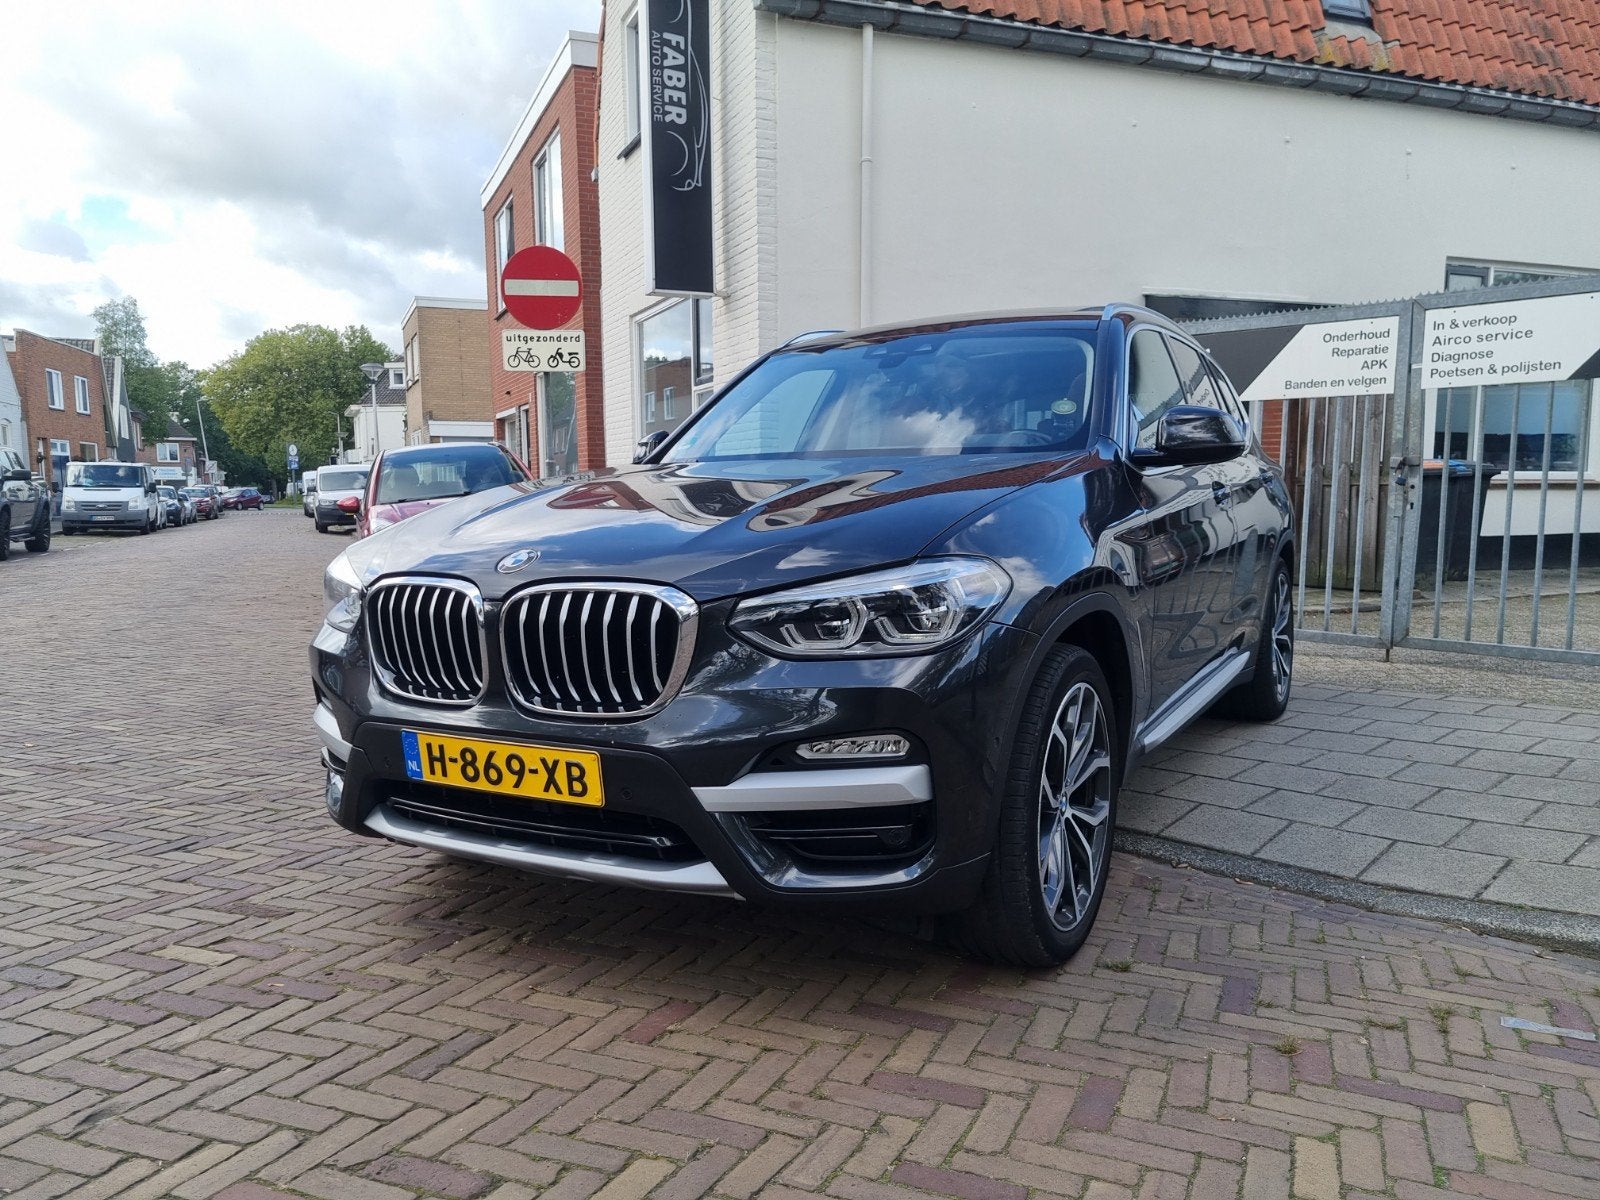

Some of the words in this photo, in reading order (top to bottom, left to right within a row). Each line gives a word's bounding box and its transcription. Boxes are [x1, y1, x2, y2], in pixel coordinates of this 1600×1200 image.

[651, 30, 662, 67] AUTO
[662, 32, 687, 125] FABER
[652, 68, 663, 123] SERVICE
[1433, 320, 1445, 331] In
[1449, 318, 1460, 330] &
[1462, 314, 1517, 328] verkoop
[506, 333, 581, 345] uitgezonderd
[1322, 328, 1391, 343] Onderhoud
[1432, 334, 1472, 347] Airco
[1476, 328, 1534, 343] service
[1331, 344, 1389, 359] Reparatie
[1431, 349, 1494, 364] Diagnose
[1361, 359, 1388, 371] APK
[1430, 366, 1484, 379] Poetsen
[1487, 363, 1498, 375] &
[1501, 359, 1562, 376] polijsten
[1284, 378, 1327, 390] Banden
[1330, 380, 1345, 388] en
[1348, 375, 1387, 388] velgen
[408, 759, 421, 772] NL
[426, 742, 589, 798] H-869-XB
